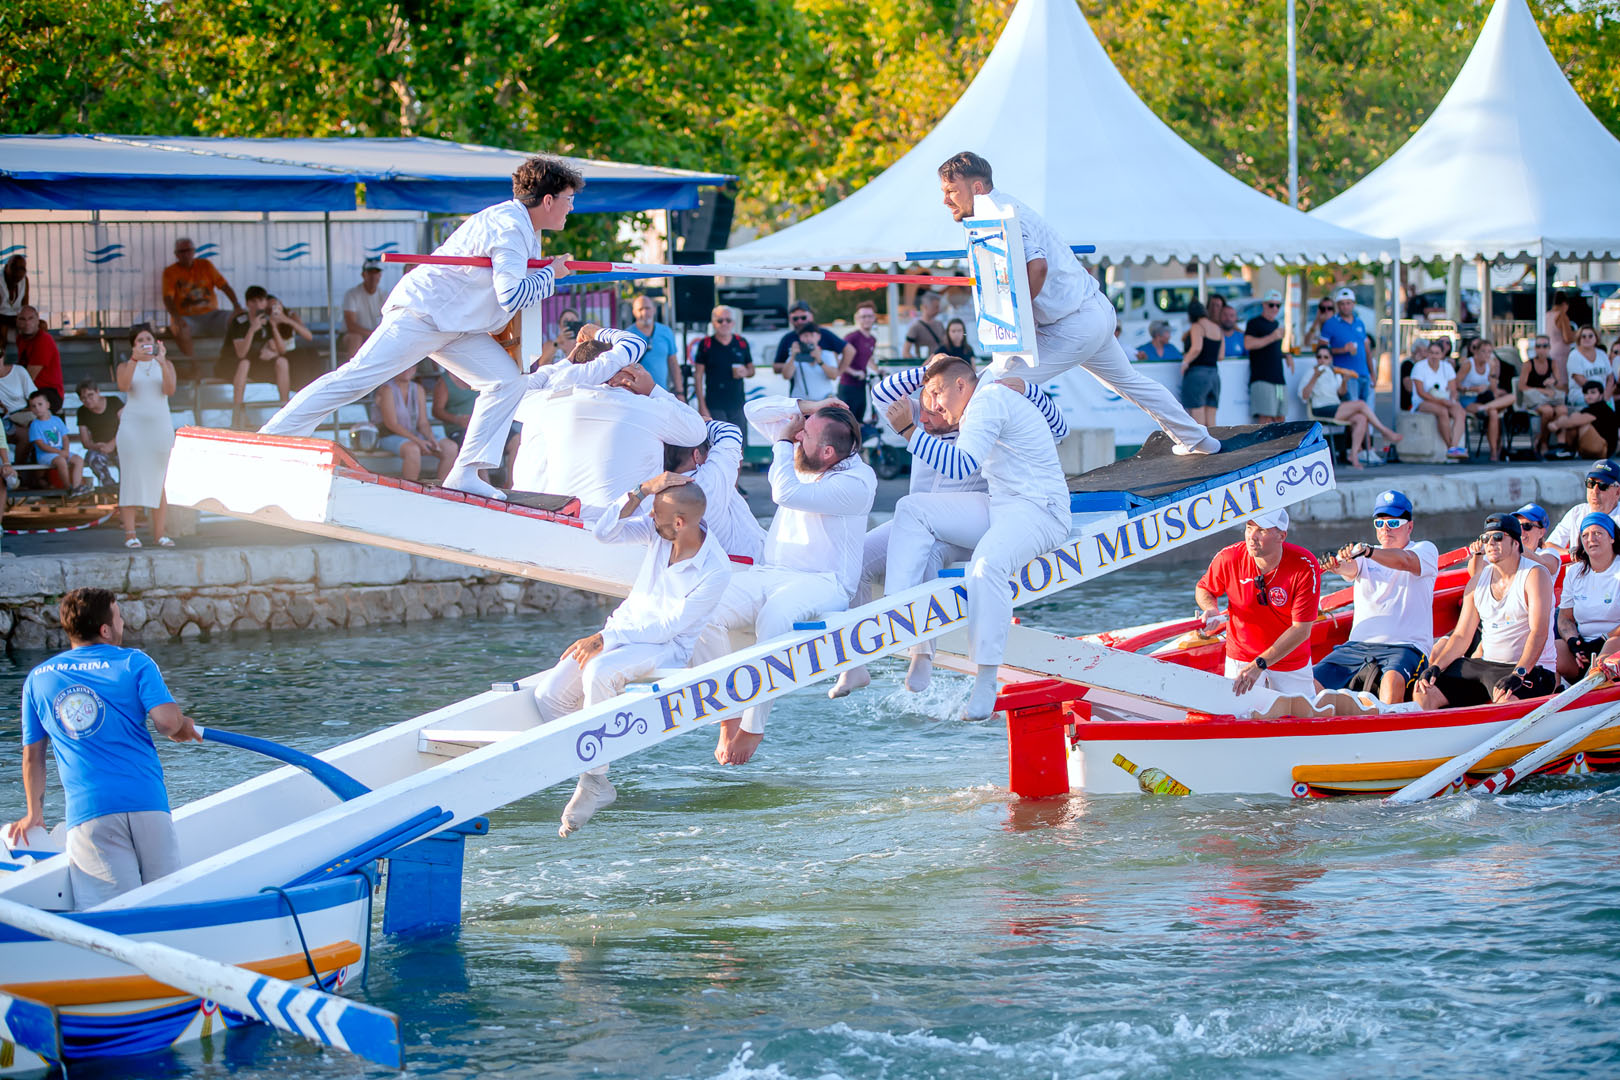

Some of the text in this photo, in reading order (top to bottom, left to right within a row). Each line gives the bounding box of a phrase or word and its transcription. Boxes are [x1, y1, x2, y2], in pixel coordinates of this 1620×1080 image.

[1093, 476, 1266, 568] MUSCAT
[34, 661, 110, 675] GIN MARINA
